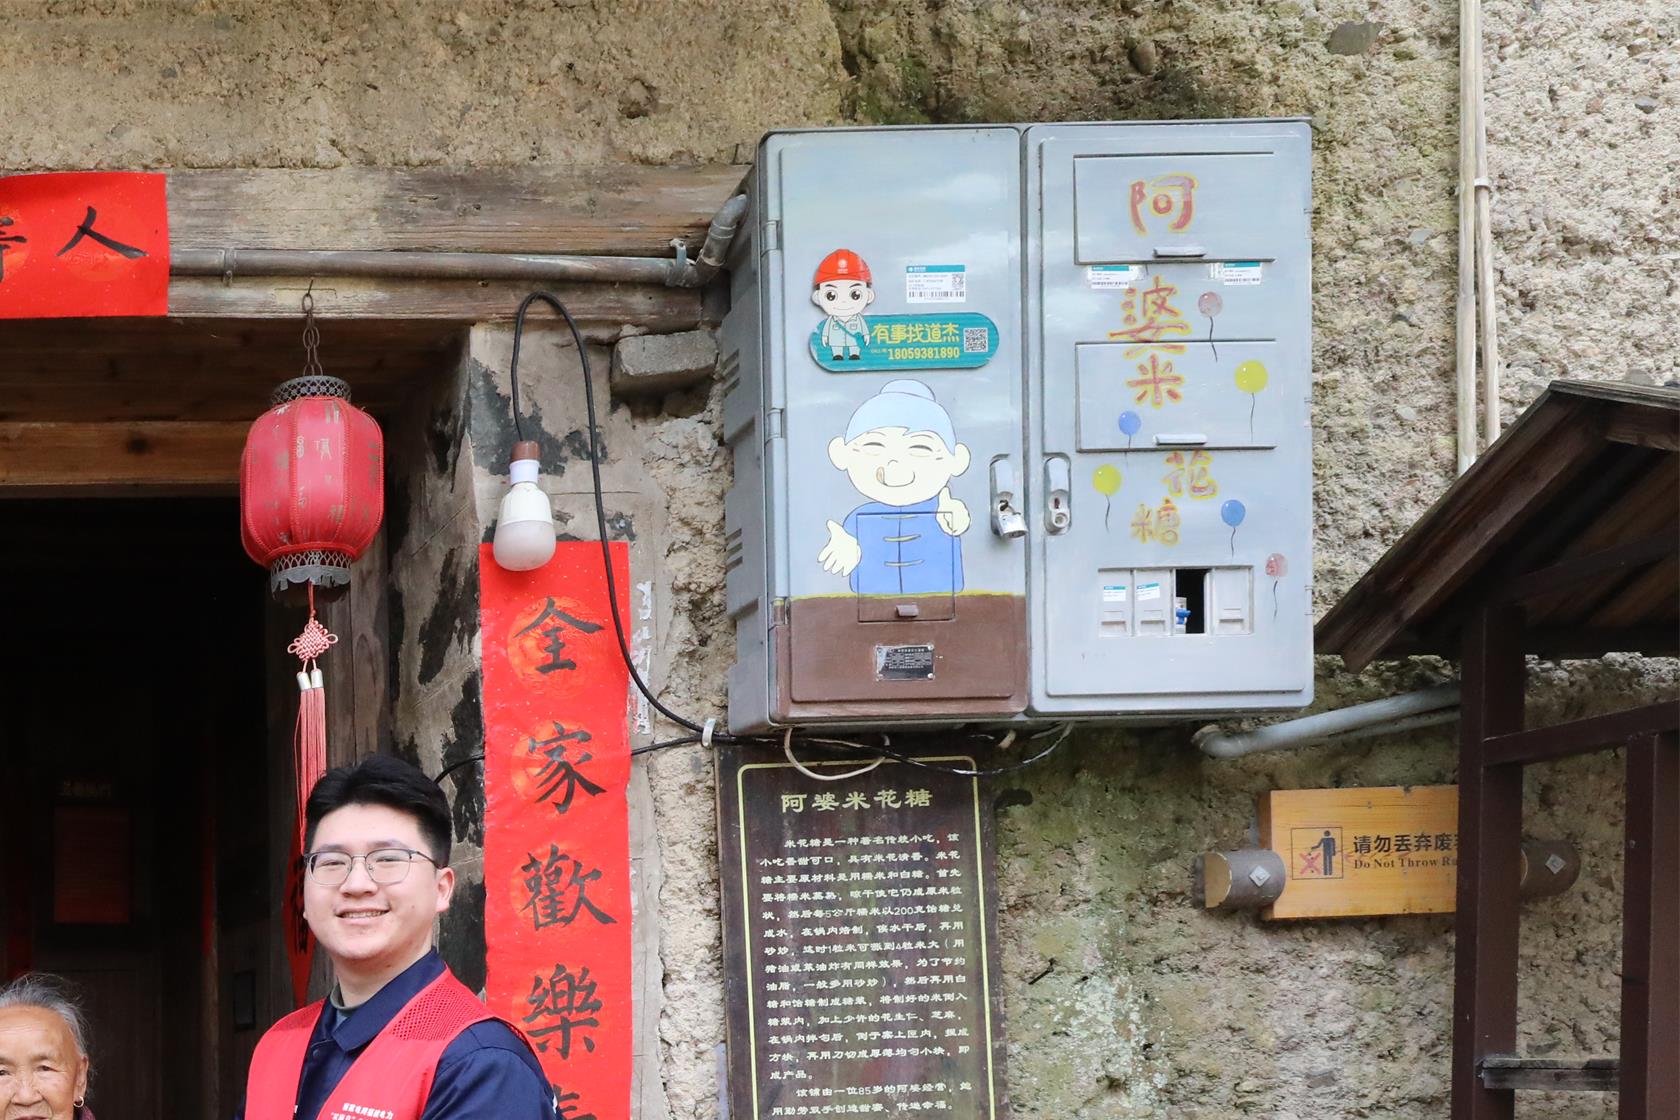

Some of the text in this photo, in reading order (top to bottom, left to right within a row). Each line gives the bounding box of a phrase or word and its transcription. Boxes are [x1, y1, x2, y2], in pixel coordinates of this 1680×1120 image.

[888, 347, 960, 361] 18059381890
[781, 789, 933, 813] 阿婆米花糖
[1353, 833, 1459, 854] 请勿丢弃废
[1354, 860, 1370, 870] Do
[1375, 859, 1396, 869] Not
[1400, 857, 1438, 868] Throw
